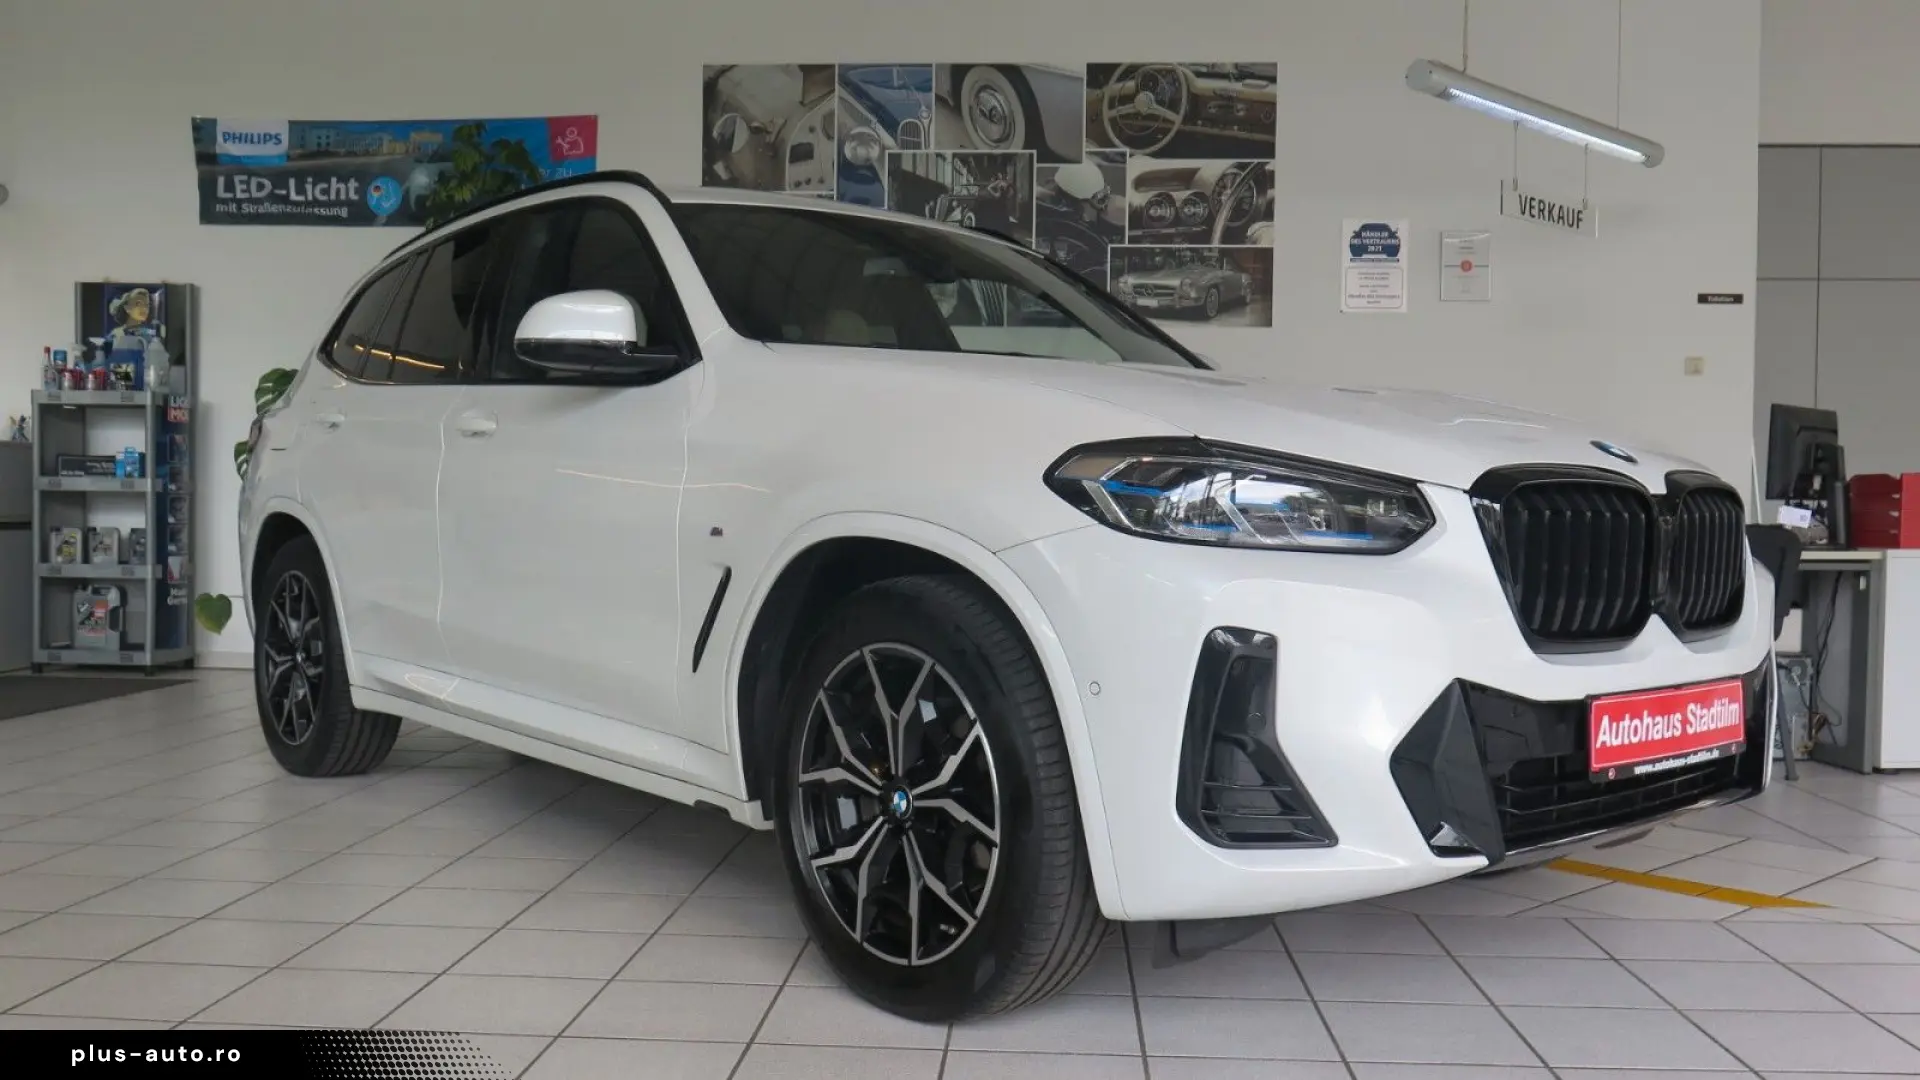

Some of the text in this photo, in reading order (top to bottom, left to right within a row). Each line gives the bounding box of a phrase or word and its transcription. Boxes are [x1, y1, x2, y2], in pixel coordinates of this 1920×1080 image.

[222, 131, 283, 146] PHILIPS
[216, 174, 360, 201] LED-Licht
[215, 203, 237, 213] mit
[1518, 193, 1583, 230] VERKAUF
[1595, 697, 1740, 749] Autohaus Stadtilm
